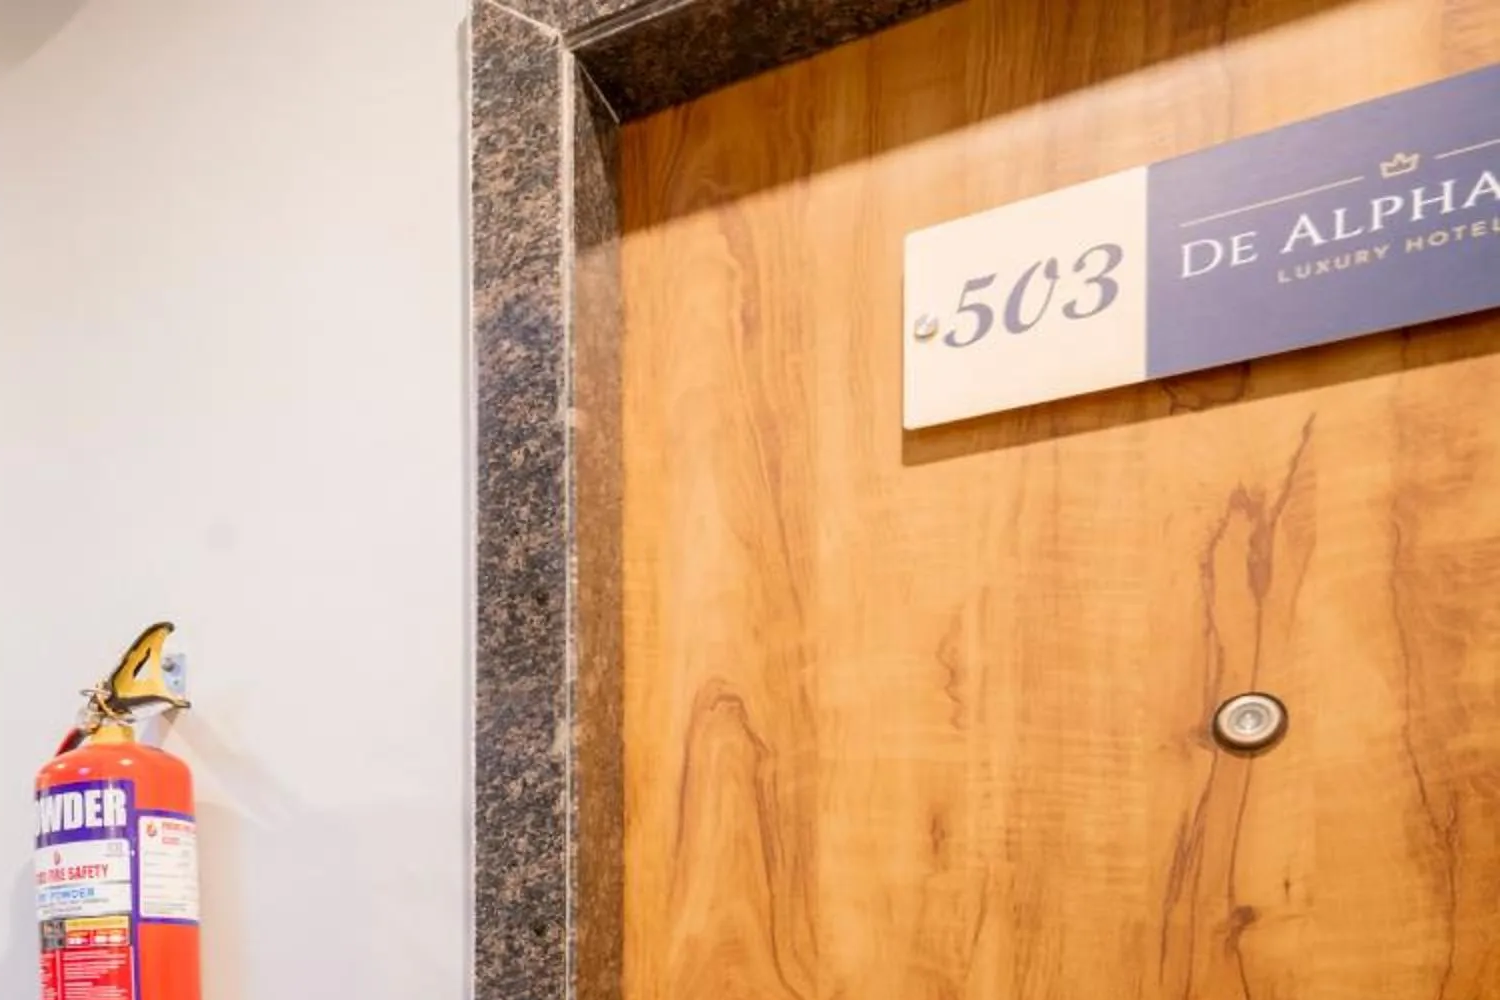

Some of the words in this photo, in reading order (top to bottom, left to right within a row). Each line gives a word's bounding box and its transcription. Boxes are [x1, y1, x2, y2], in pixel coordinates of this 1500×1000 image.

[1180, 231, 1259, 279] DE
[1279, 170, 1500, 254] ALPHA
[1277, 244, 1390, 284] LUXURY
[1404, 217, 1500, 254] HOTEL
[943, 242, 1124, 348] 503
[35, 788, 128, 836] WDER
[67, 864, 109, 881] SAFETY
